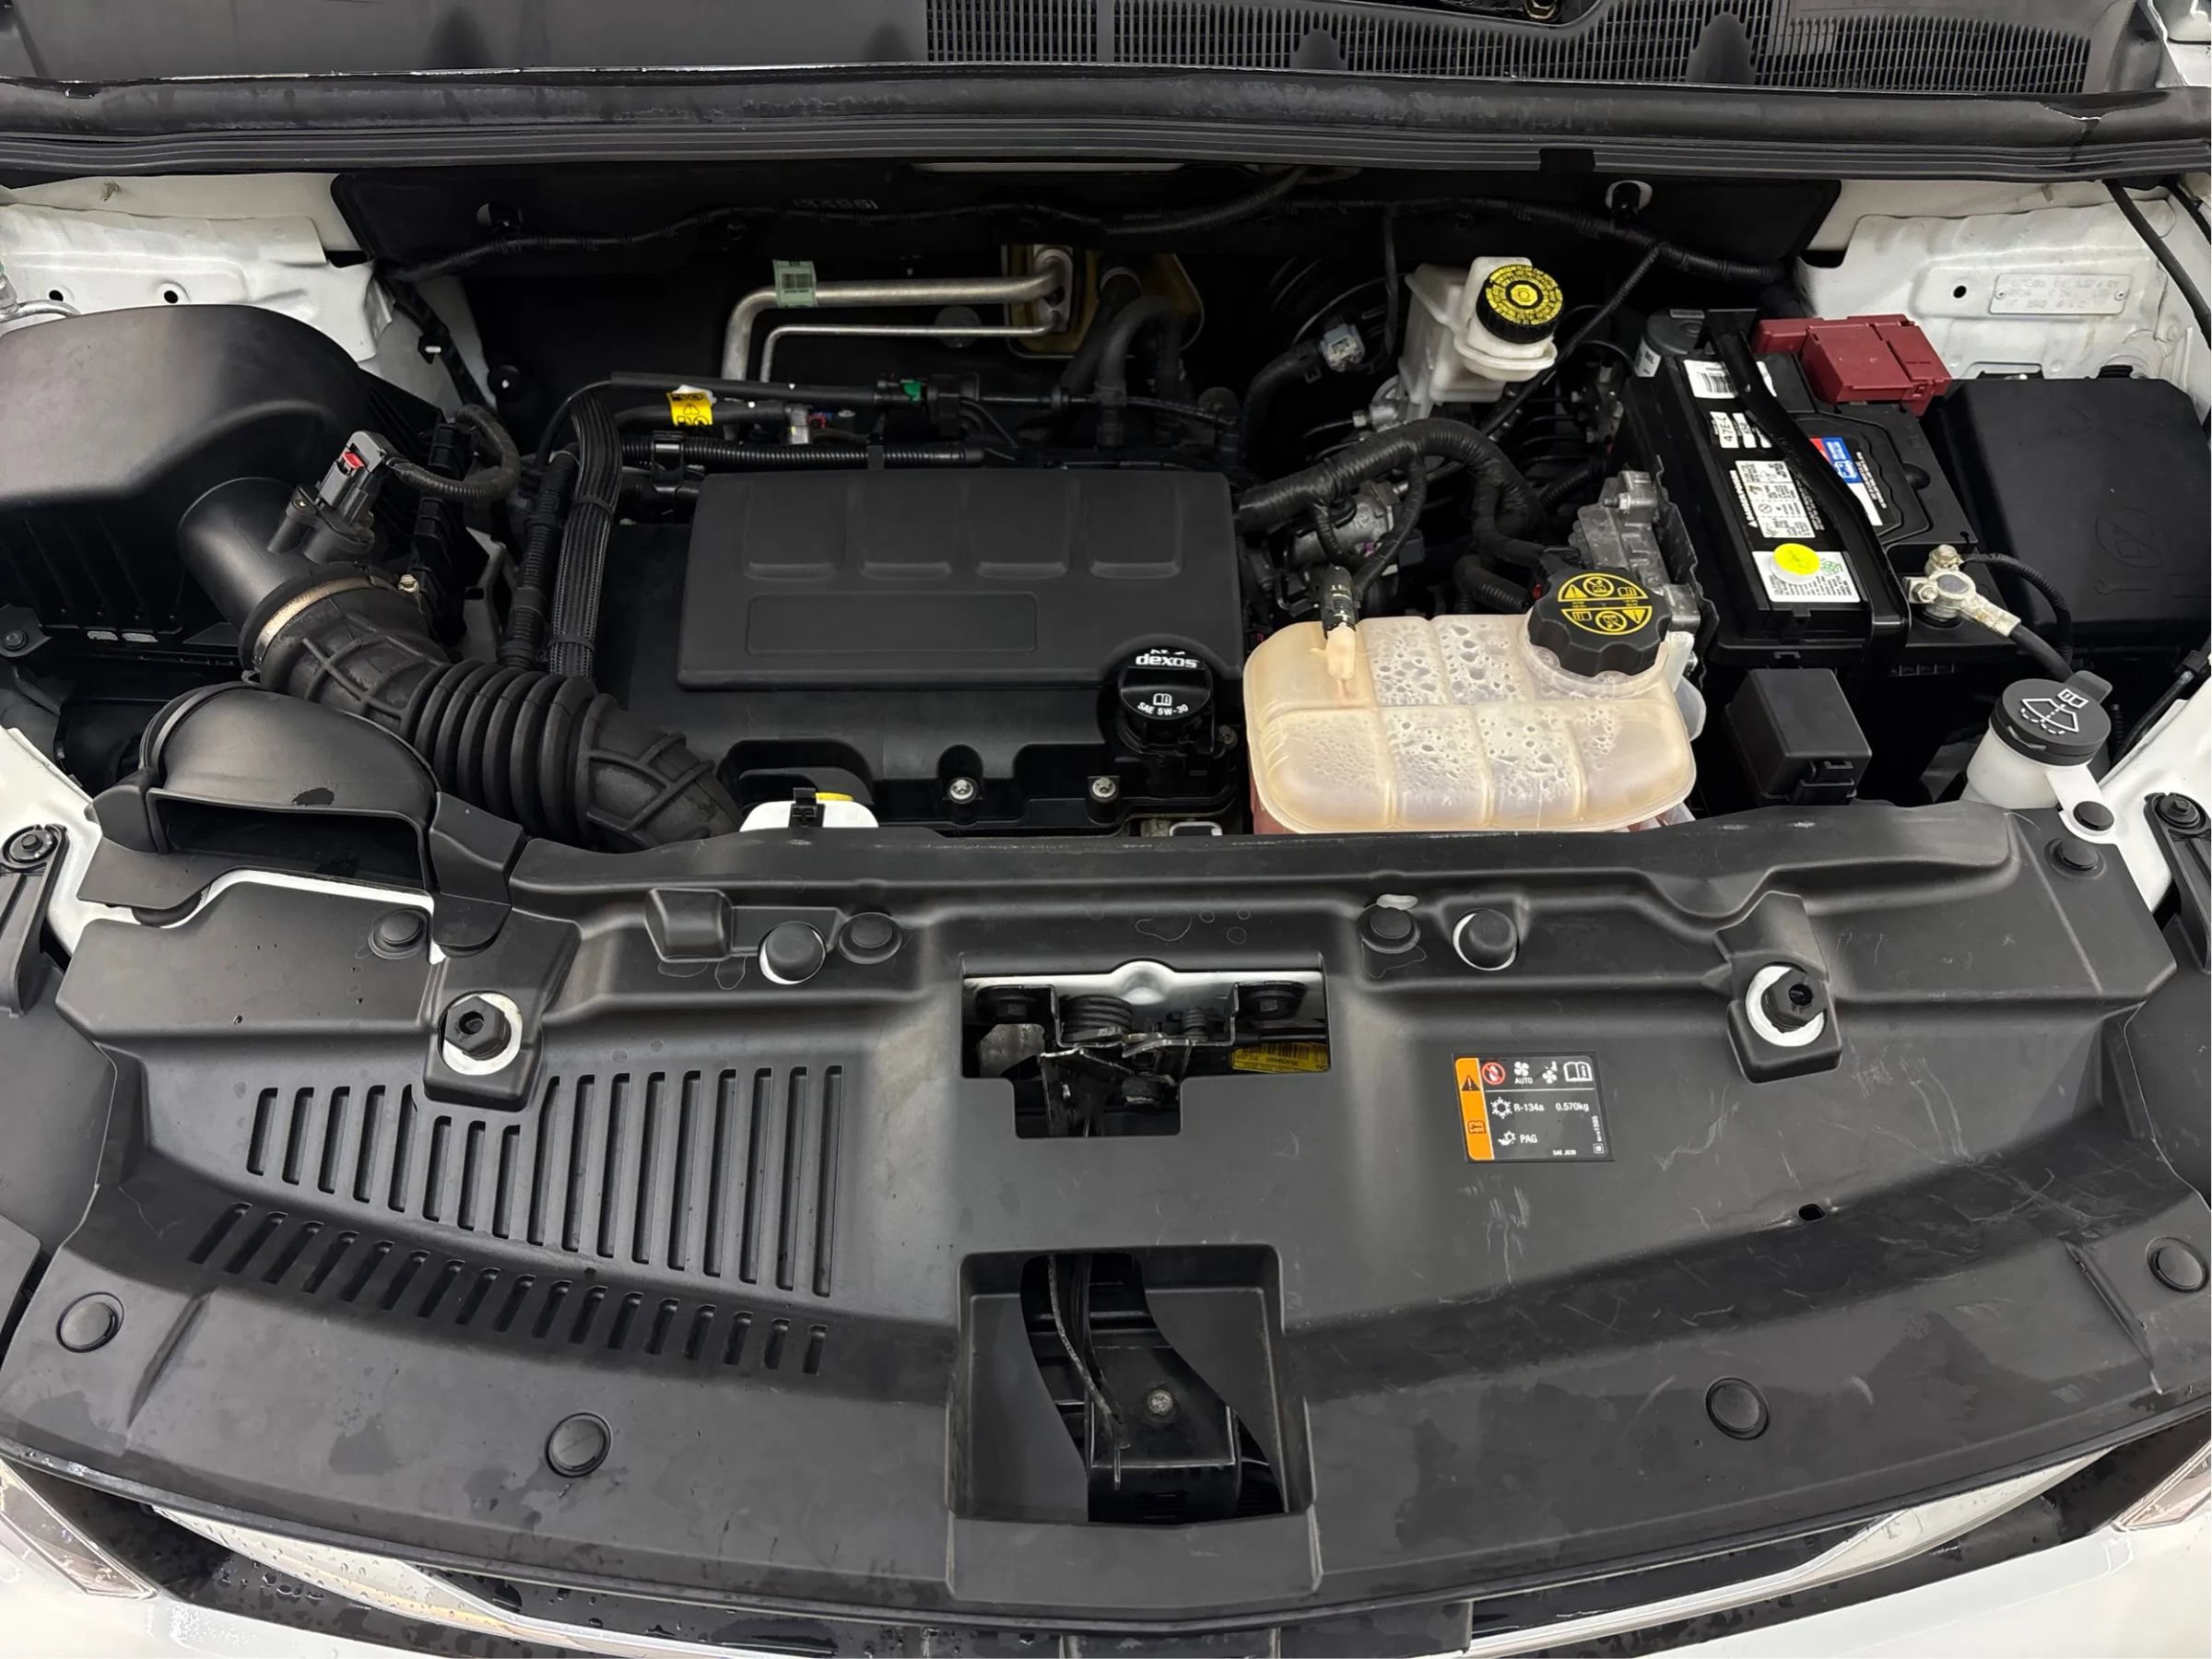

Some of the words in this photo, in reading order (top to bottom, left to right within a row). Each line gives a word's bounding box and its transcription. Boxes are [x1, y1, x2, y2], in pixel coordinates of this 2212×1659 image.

[1135, 653, 1200, 668] dexos
[1137, 701, 1156, 714] SAE
[1157, 704, 1189, 715] 5W-30
[1514, 1077, 1534, 1085] AUTO
[1513, 1102, 1545, 1112] R-134a
[1555, 1102, 1590, 1112] 0.570kg
[1520, 1134, 1538, 1144] PAG
